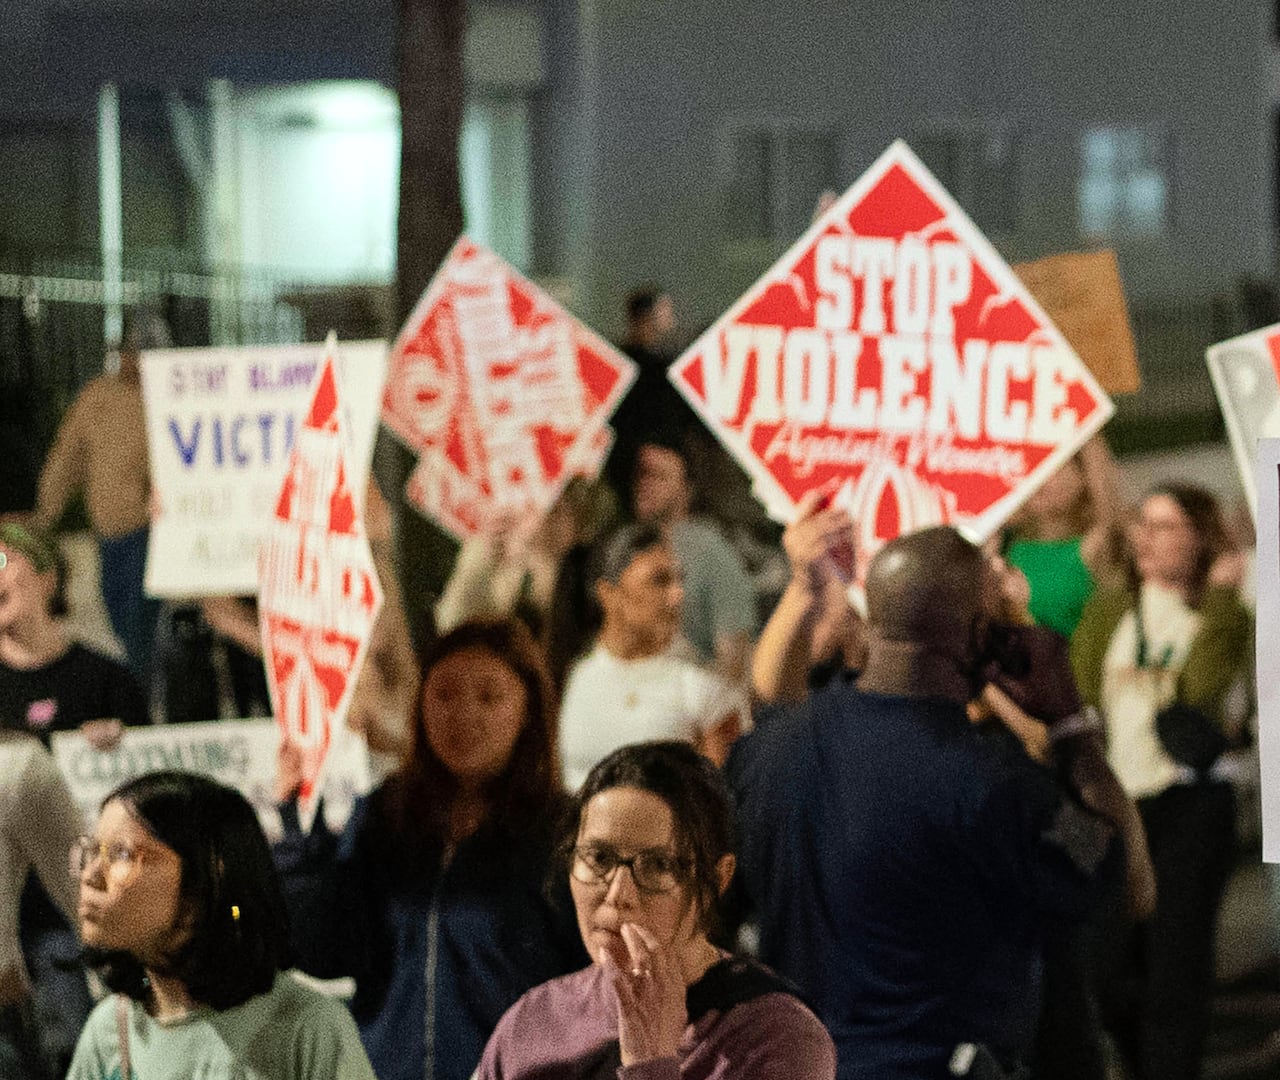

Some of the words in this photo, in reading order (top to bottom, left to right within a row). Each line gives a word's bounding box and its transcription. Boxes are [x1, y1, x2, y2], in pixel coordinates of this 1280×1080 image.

[813, 236, 972, 335] STOP
[702, 325, 1077, 443] VIOLENCE
[167, 412, 298, 470] VICTI
